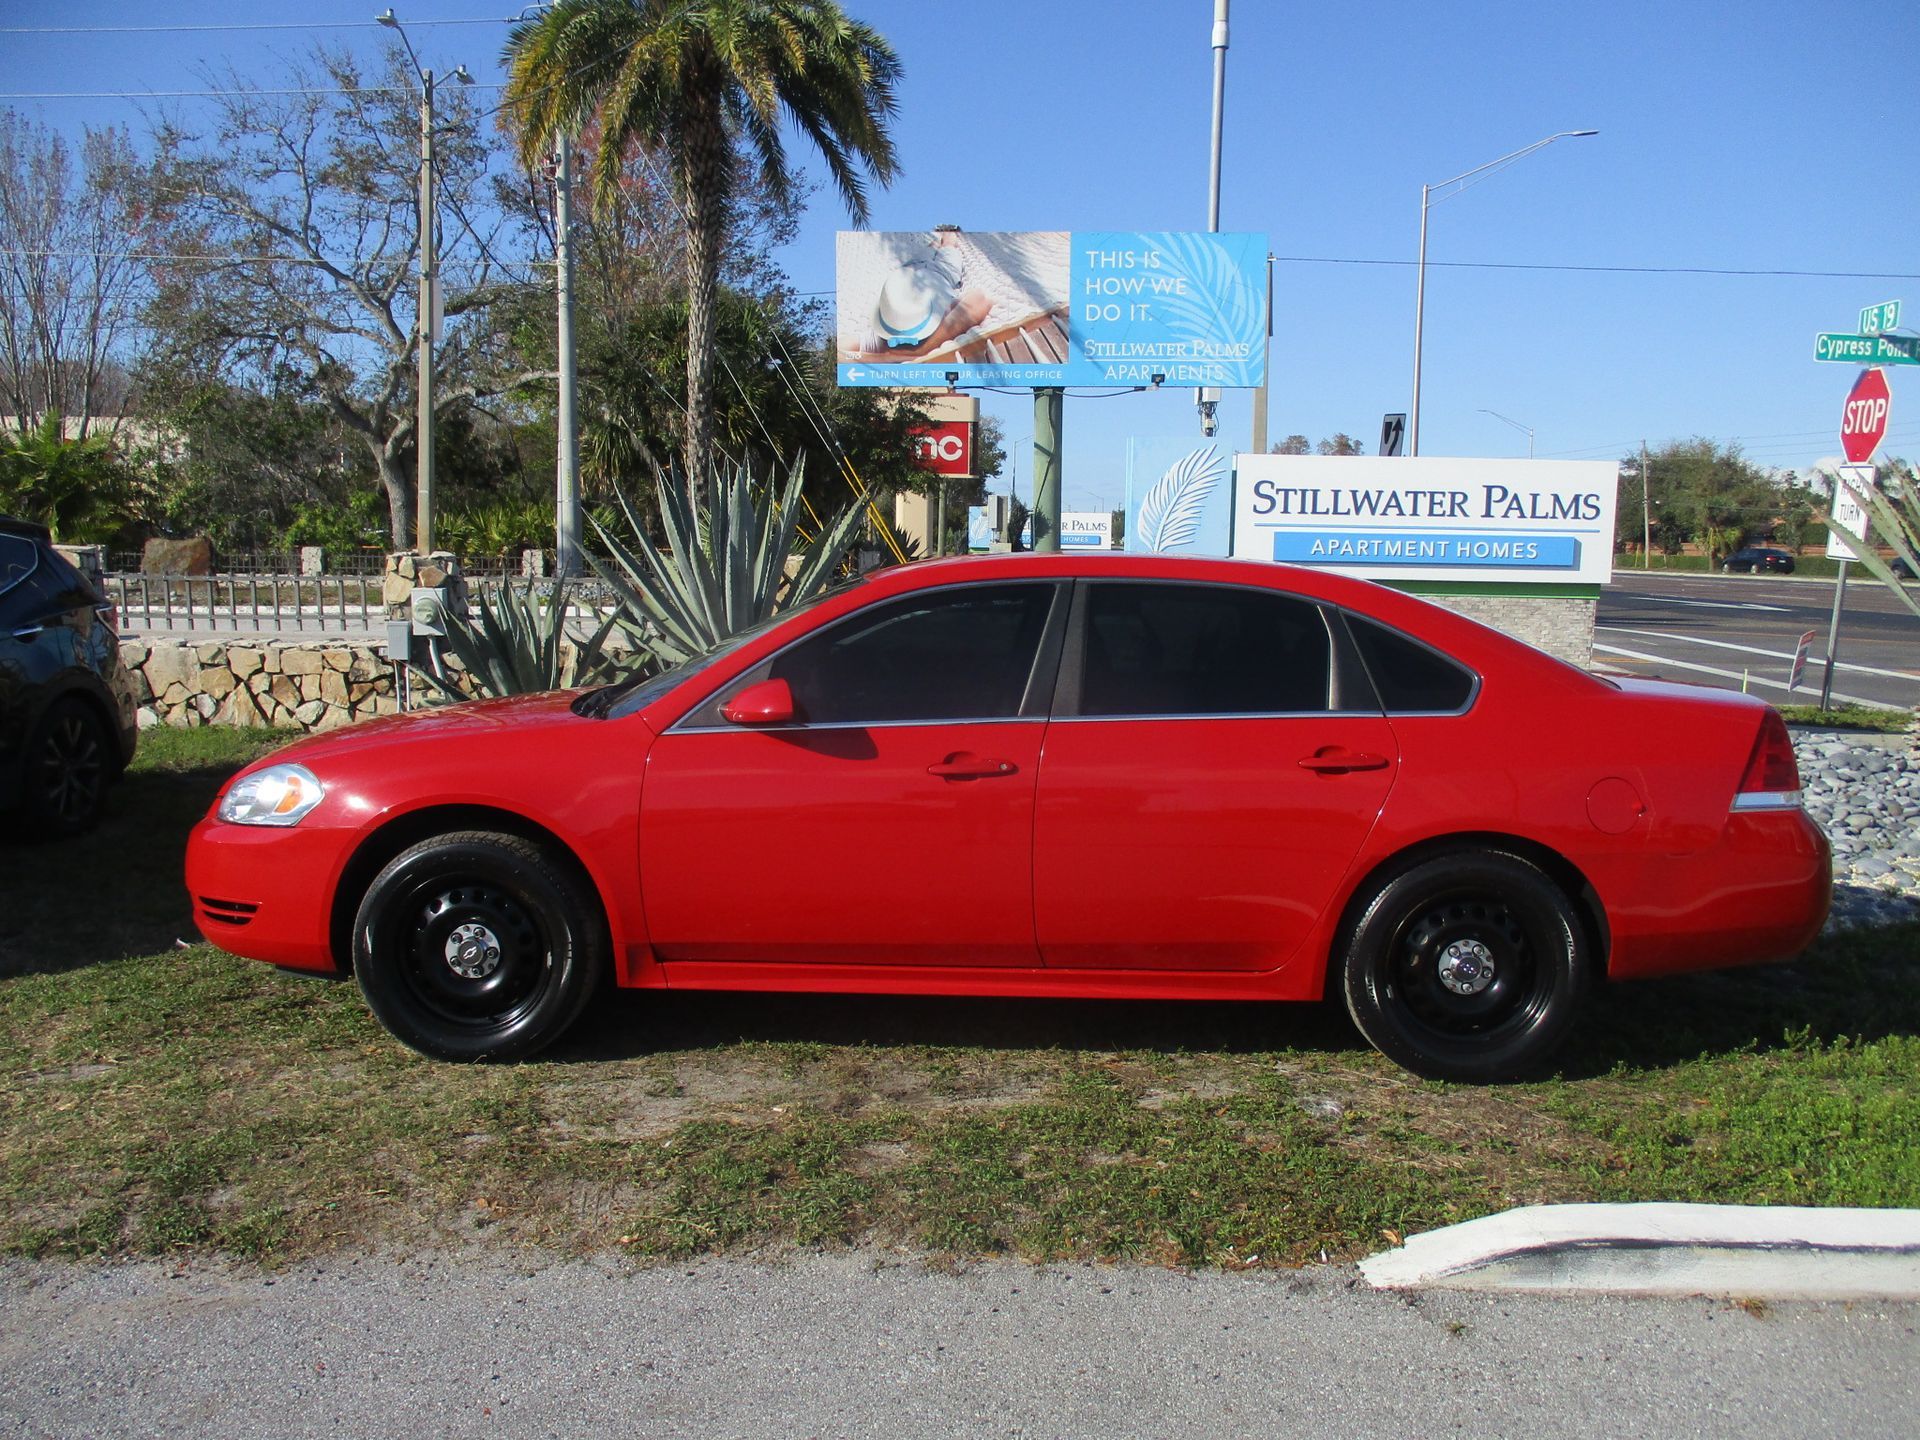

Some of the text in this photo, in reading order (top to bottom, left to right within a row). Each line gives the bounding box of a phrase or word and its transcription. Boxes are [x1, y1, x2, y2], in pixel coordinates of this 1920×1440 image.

[1086, 251, 1160, 268] THIS IS
[1086, 277, 1187, 295] HOW WE
[1086, 304, 1153, 321] DO IT.
[1862, 304, 1896, 333] US 19
[1817, 335, 1872, 359] Cypress
[869, 370, 899, 379] TURN
[903, 370, 927, 379] LEFT
[930, 370, 945, 379] TO
[976, 370, 1020, 379] LEASING
[1024, 370, 1063, 379] OFFICE
[1104, 365, 1224, 380] APARTMENTS
[1843, 398, 1886, 434] STOP
[1840, 504, 1861, 521] TURN
[1310, 539, 1539, 560] APARTMENT HOMES
